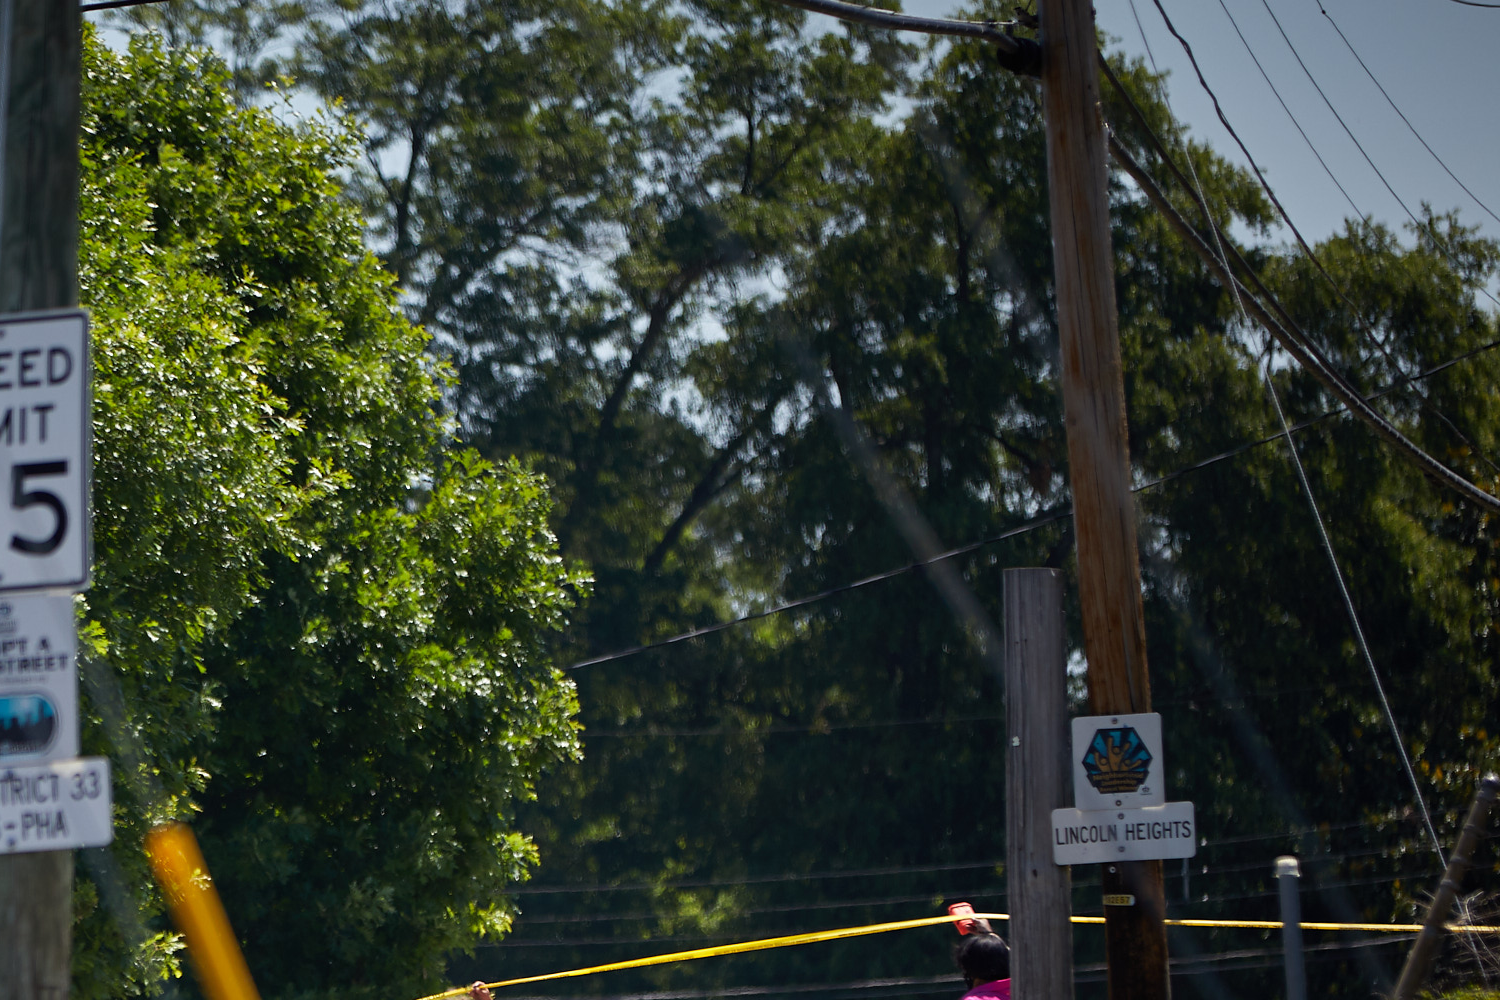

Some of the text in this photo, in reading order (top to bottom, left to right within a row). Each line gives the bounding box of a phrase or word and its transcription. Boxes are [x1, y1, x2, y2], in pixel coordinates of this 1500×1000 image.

[71, 771, 100, 800] 33
[1055, 820, 1192, 845] LINCOLN HEIGHTS
